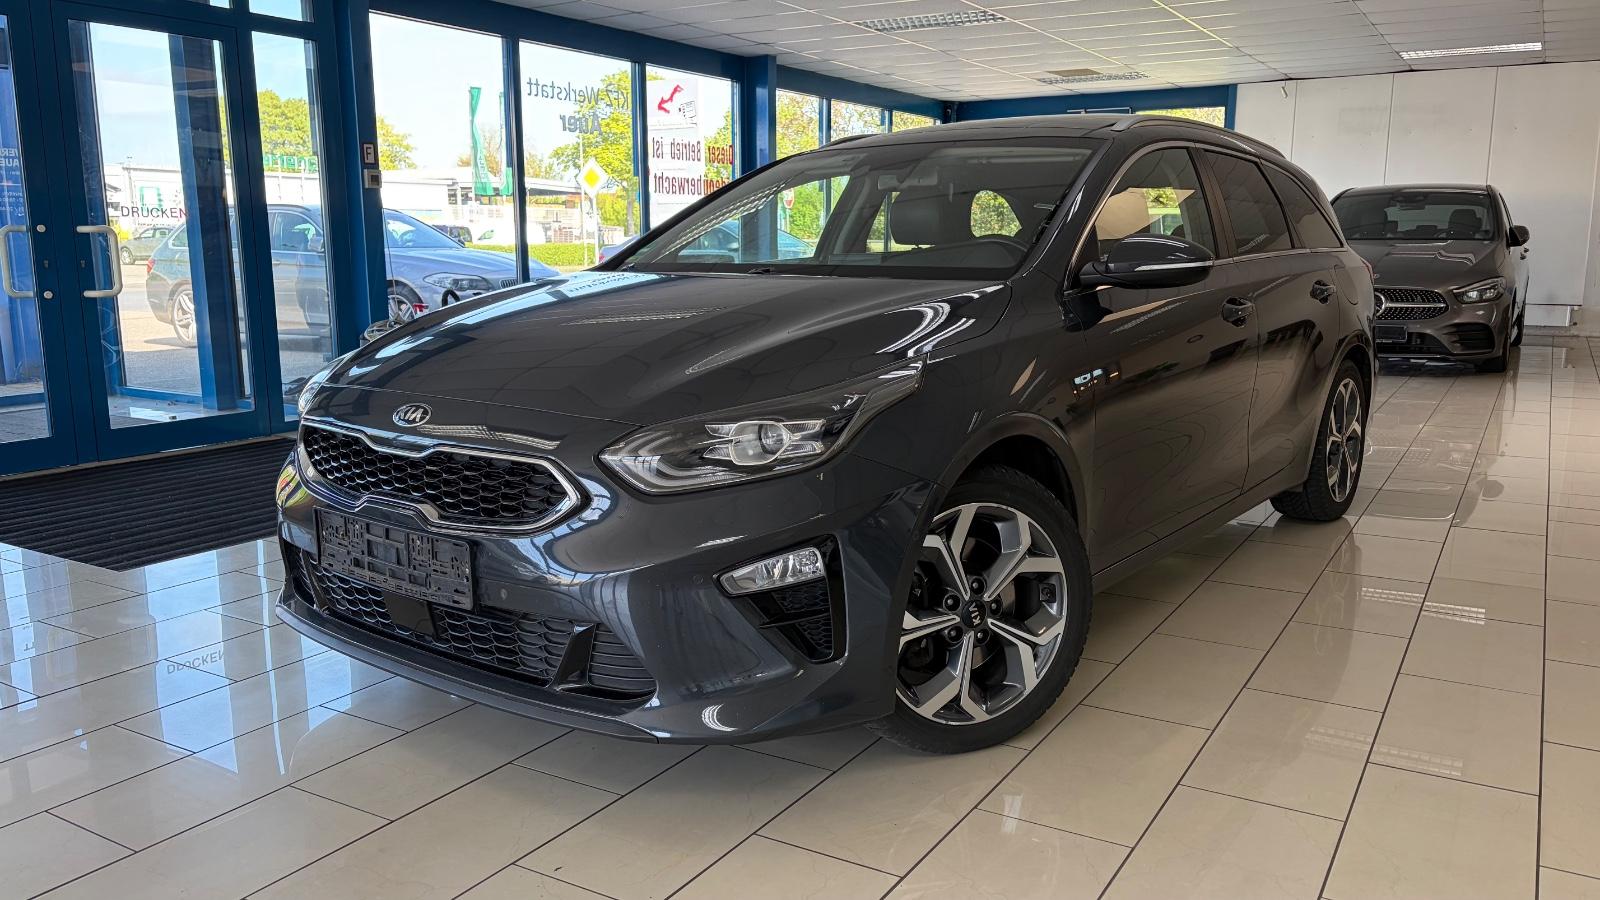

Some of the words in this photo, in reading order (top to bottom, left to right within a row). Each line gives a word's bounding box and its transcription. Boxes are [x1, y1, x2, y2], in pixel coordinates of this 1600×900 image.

[365, 146, 373, 161] F
[120, 203, 191, 219] DRÜCKEN
[969, 601, 981, 627] KIA
